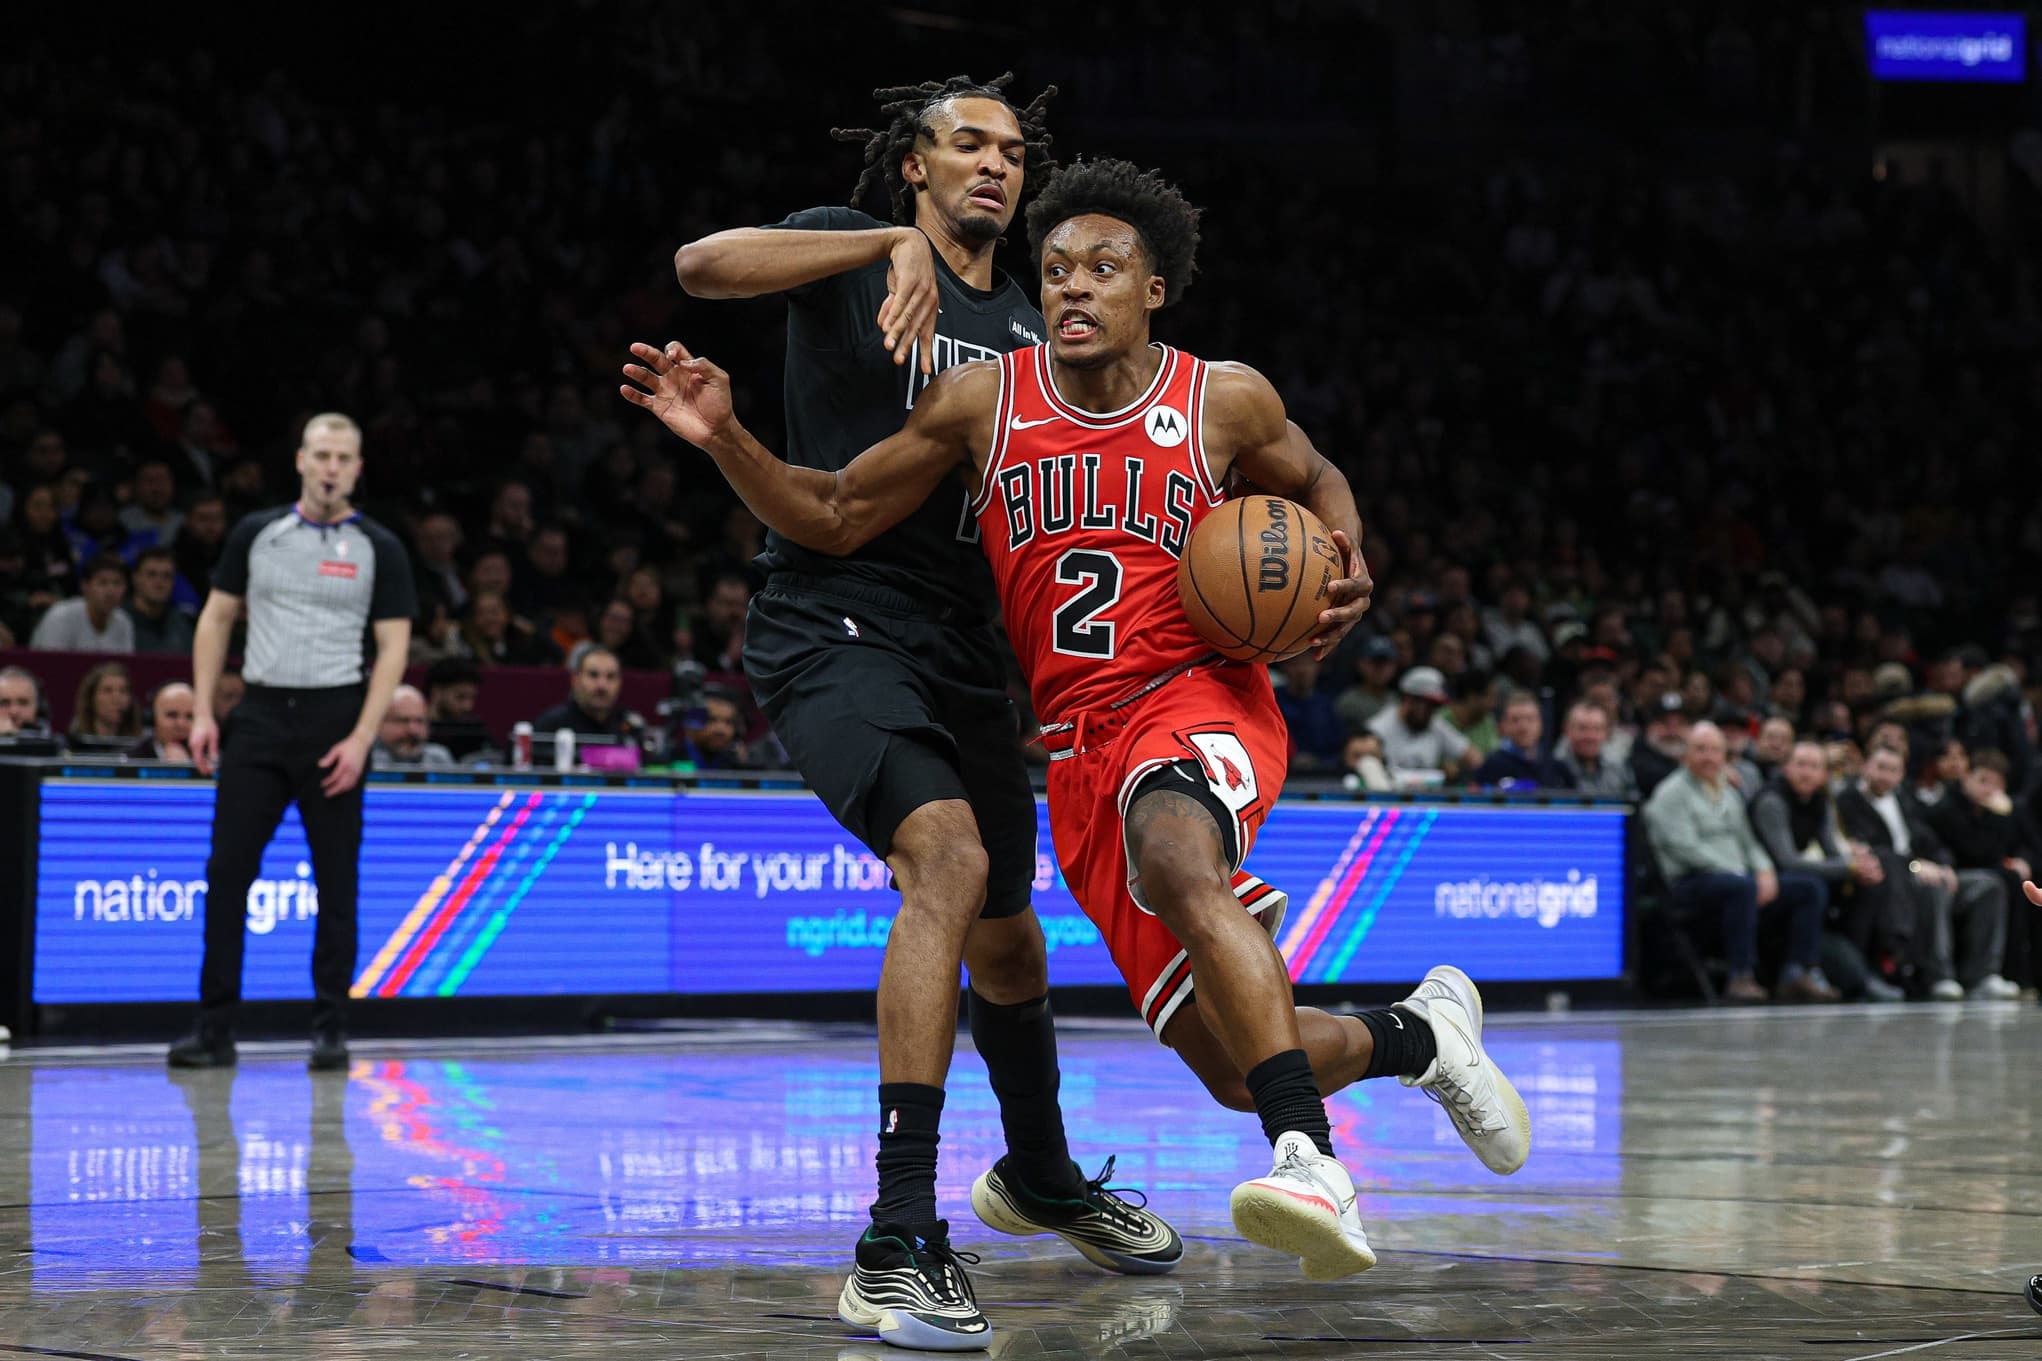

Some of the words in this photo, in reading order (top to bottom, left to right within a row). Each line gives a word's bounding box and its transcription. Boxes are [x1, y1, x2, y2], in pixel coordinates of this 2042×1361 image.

[1012, 321, 1022, 336] All
[1023, 327, 1031, 340] In
[998, 453, 1196, 561] BULLS
[1258, 499, 1289, 593] Wilson
[1053, 548, 1124, 660] 2
[605, 841, 693, 891] Here
[699, 842, 748, 891] for
[753, 852, 830, 898] your
[1434, 868, 1598, 929] nationalgrid
